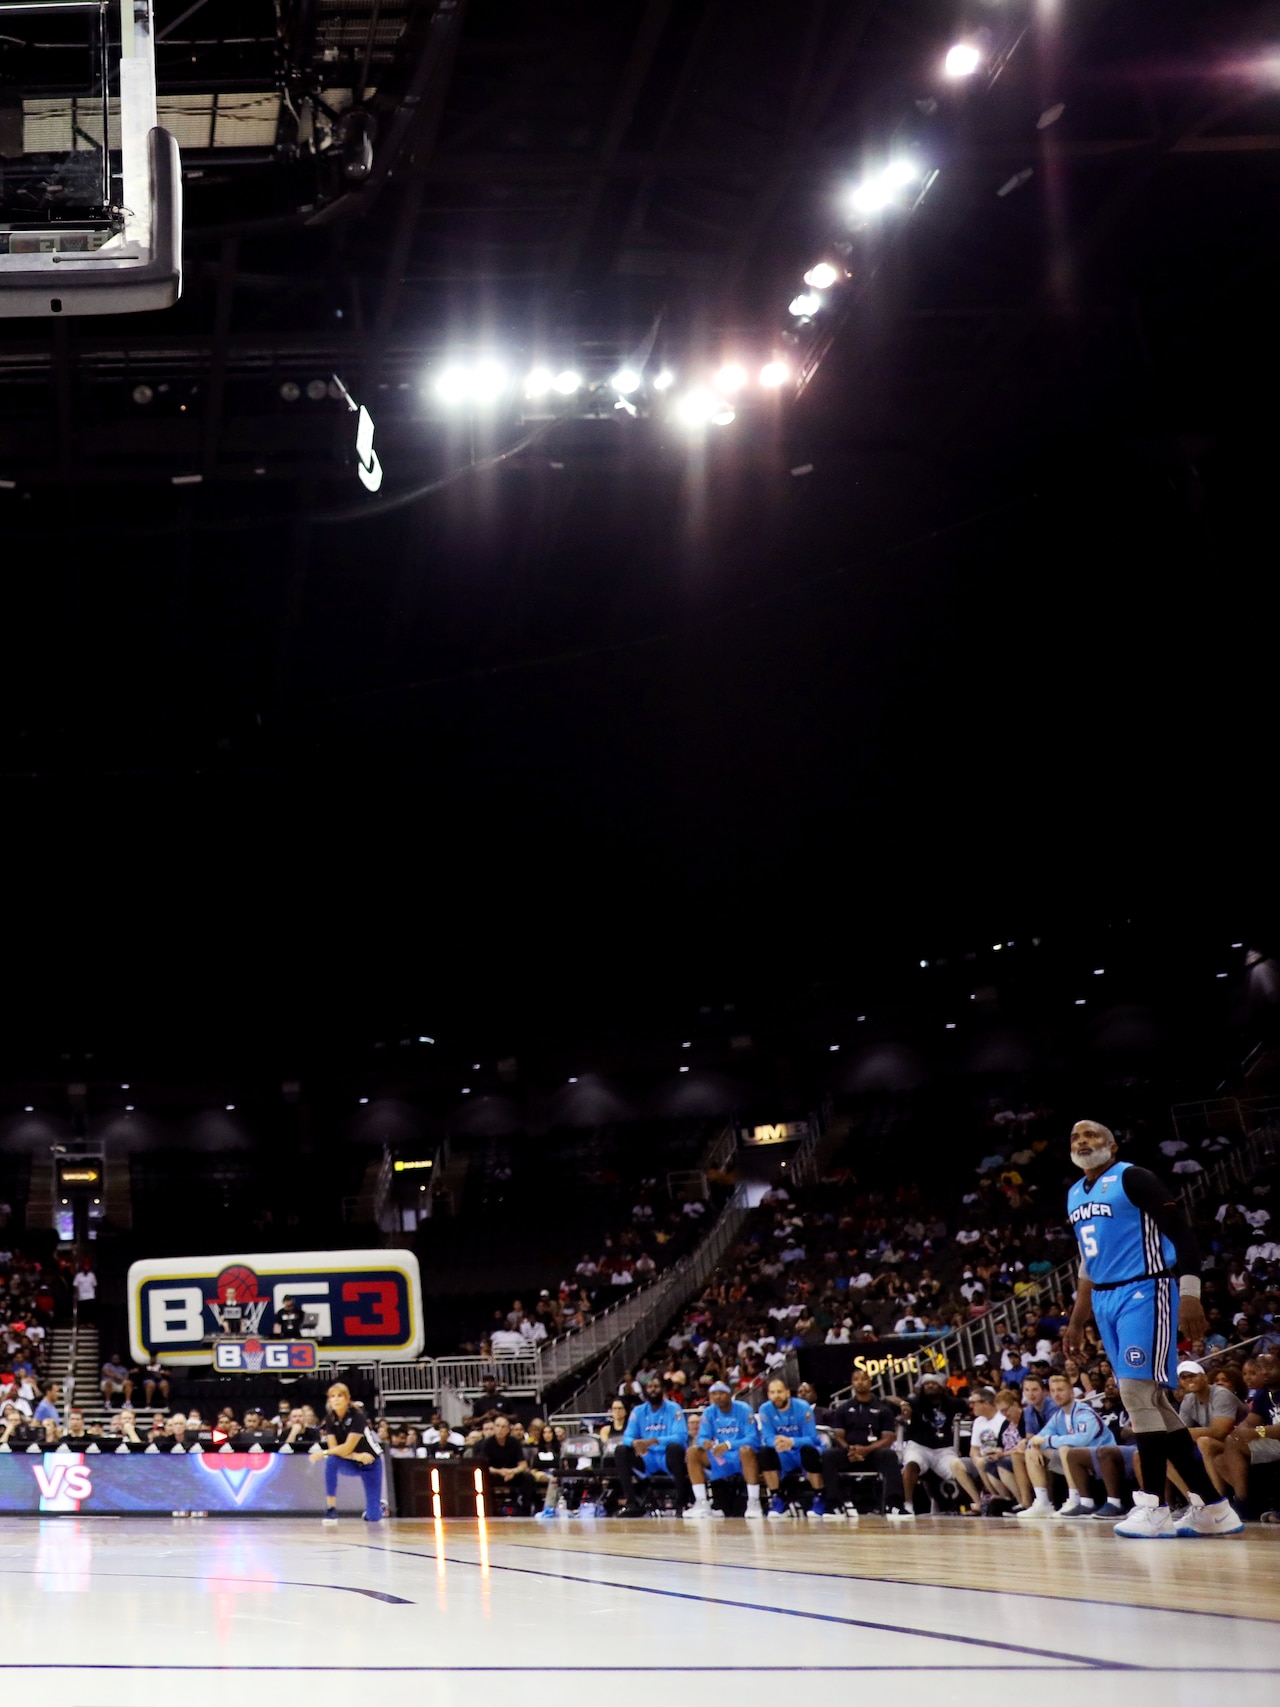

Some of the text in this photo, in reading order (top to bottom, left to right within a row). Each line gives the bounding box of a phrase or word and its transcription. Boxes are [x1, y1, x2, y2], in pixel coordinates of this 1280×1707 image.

[1080, 1225, 1098, 1258] 5
[853, 1353, 920, 1379] Sprint
[32, 1464, 92, 1499] VS
